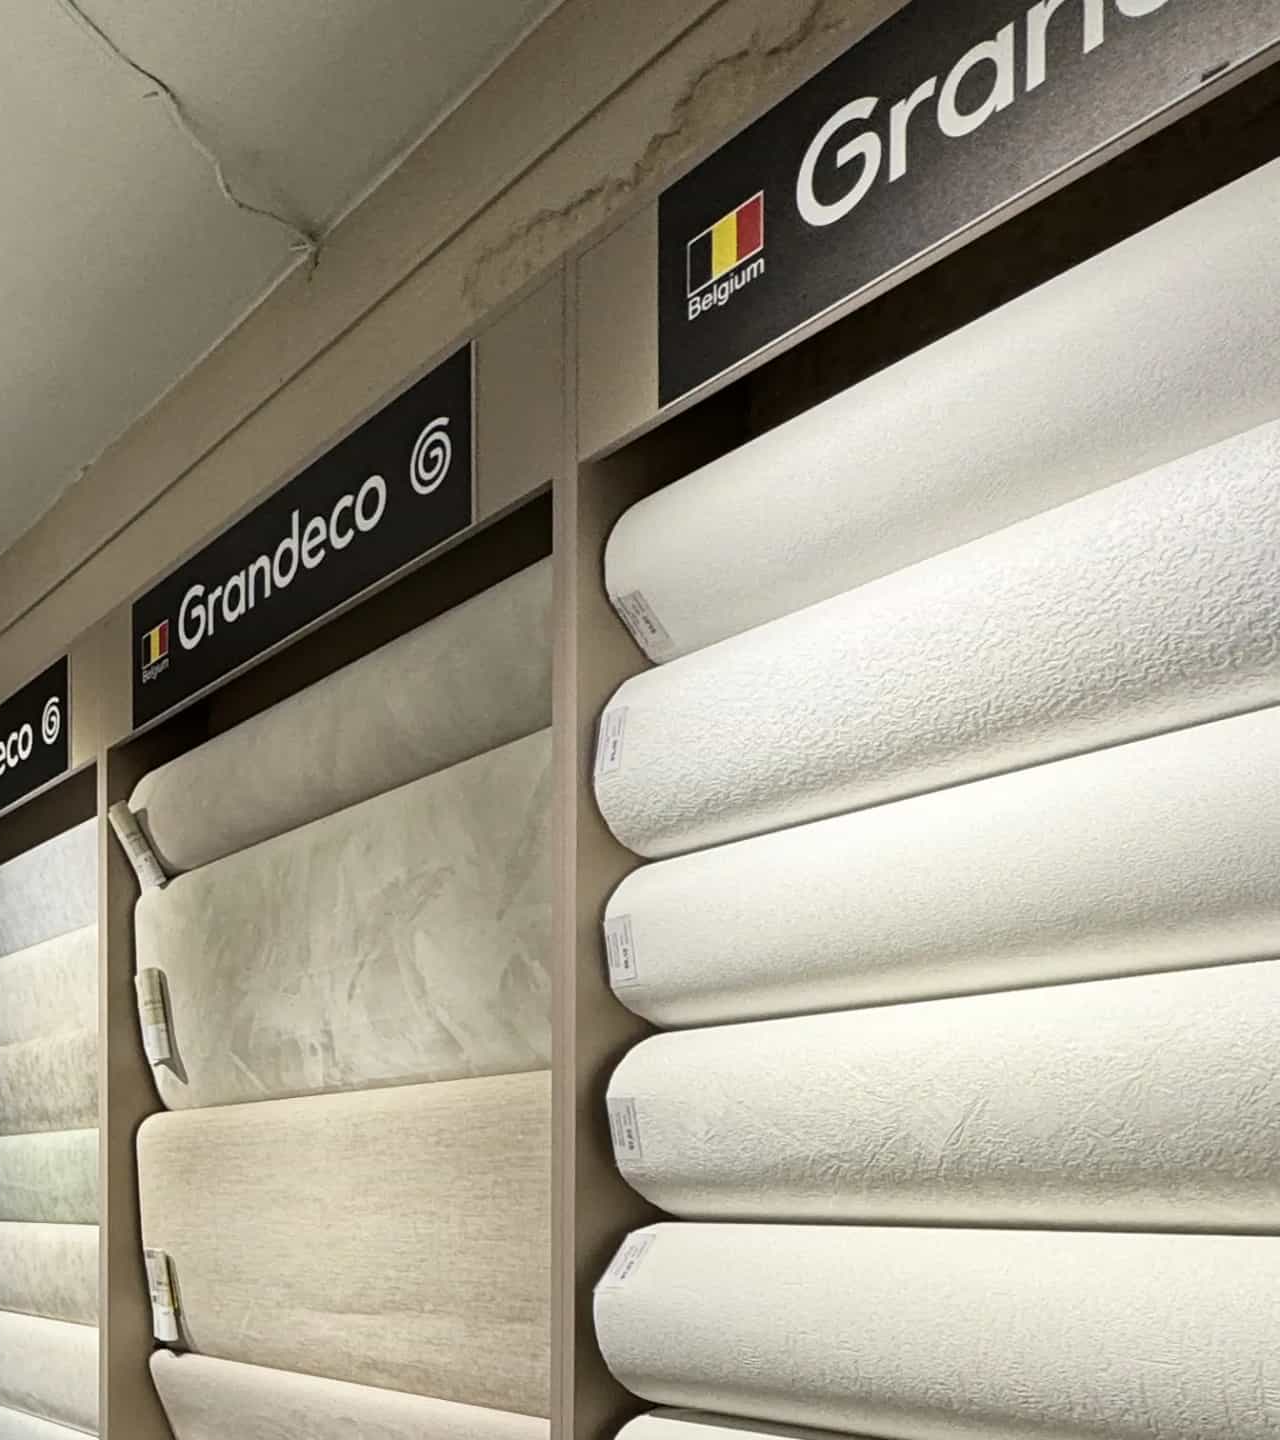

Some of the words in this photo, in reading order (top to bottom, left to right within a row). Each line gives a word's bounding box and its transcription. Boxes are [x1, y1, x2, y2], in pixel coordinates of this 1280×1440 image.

[796, 0, 1169, 227] Gran
[688, 256, 765, 320] Belgium
[177, 473, 387, 650] Grandeco
